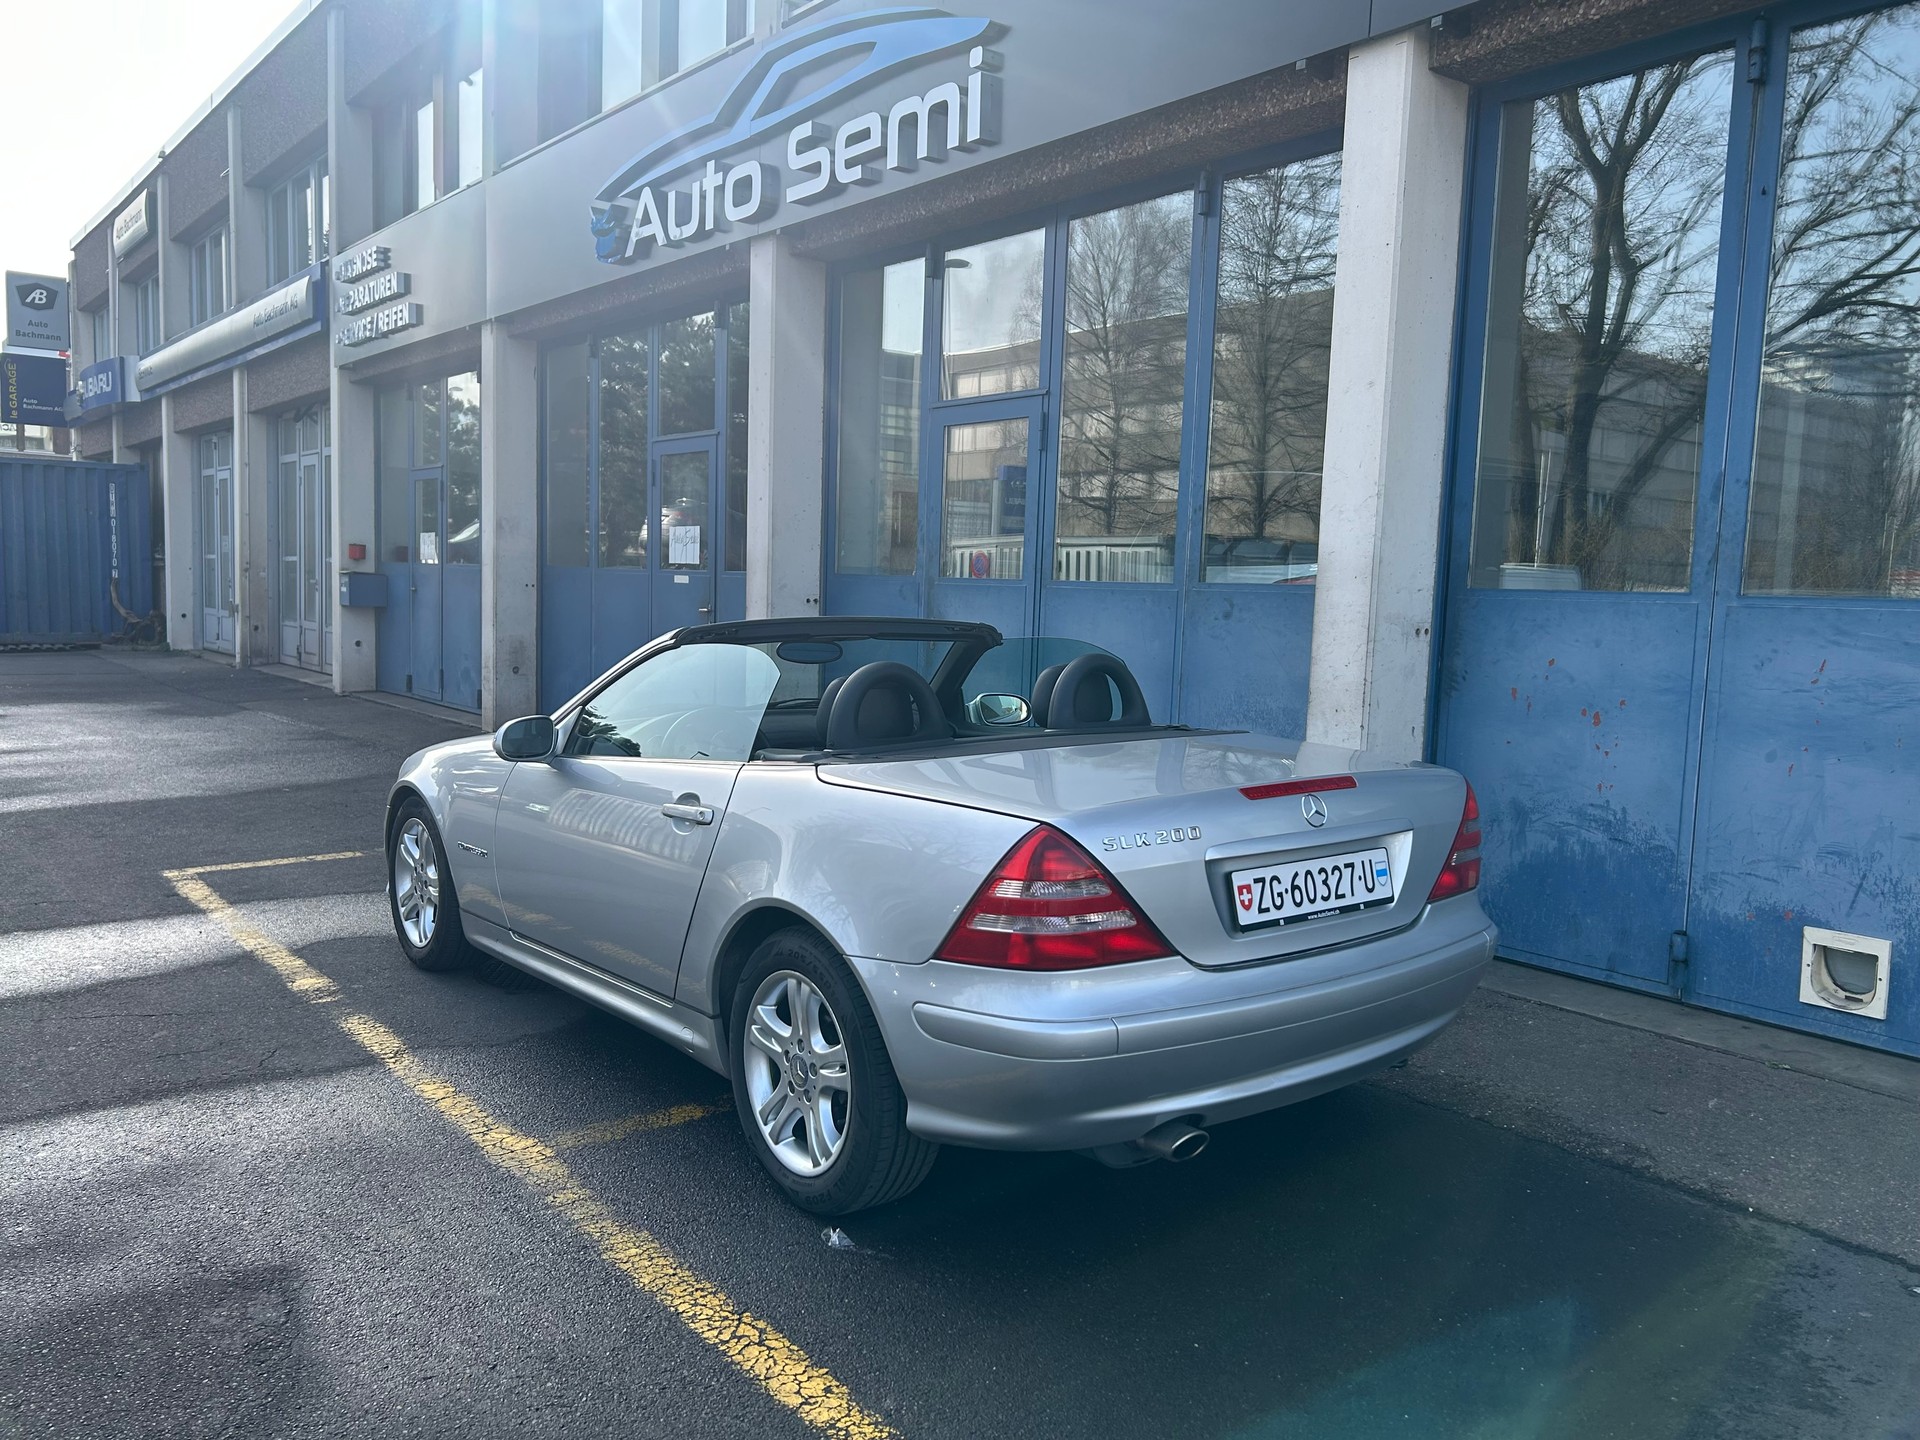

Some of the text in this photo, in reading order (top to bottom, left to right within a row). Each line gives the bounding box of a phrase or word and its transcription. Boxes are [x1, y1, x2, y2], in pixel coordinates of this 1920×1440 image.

[625, 45, 984, 258] Auto Semi
[15, 329, 62, 342] Bachmann
[27, 319, 49, 329] Auto
[8, 363, 17, 408] GARAGE
[1102, 825, 1202, 851] SLK 200
